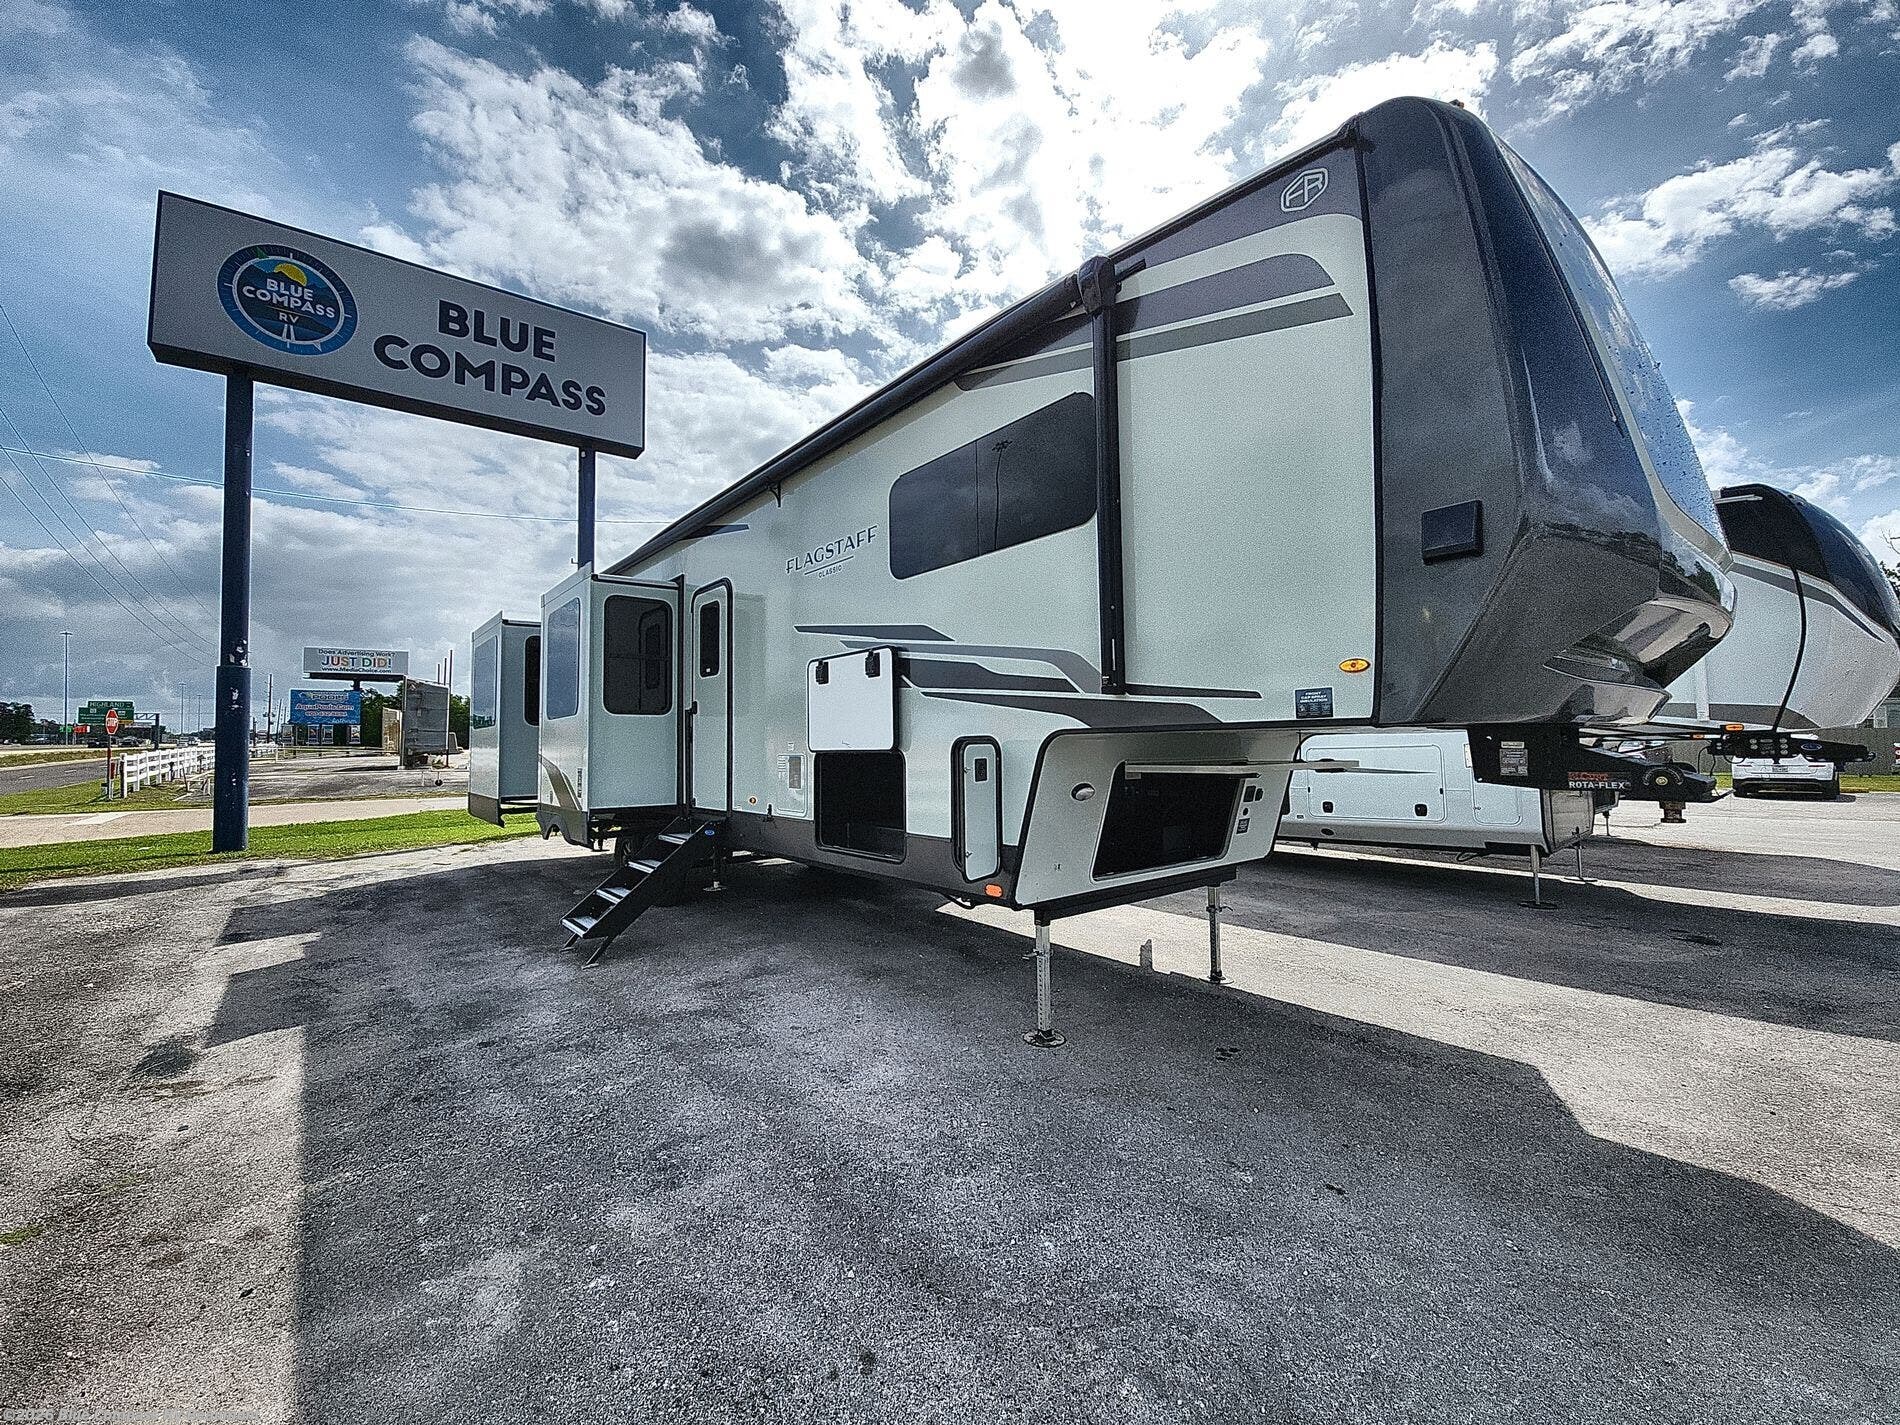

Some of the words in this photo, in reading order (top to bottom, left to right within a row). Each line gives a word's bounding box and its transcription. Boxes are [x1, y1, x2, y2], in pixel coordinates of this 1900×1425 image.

[266, 278, 313, 301] BLUE
[242, 285, 336, 318] COMPASS
[279, 312, 299, 324] RV
[438, 300, 556, 362] BLUE
[373, 335, 606, 416] COMPASS
[786, 525, 878, 574] FLAGSTAFF
[818, 565, 842, 578] CLASSIC
[337, 649, 374, 657] Advertising
[322, 656, 357, 667] JUST
[362, 657, 392, 668] DID!
[107, 718, 118, 726] STOP
[1569, 781, 1625, 789] ROTA-FLEX
